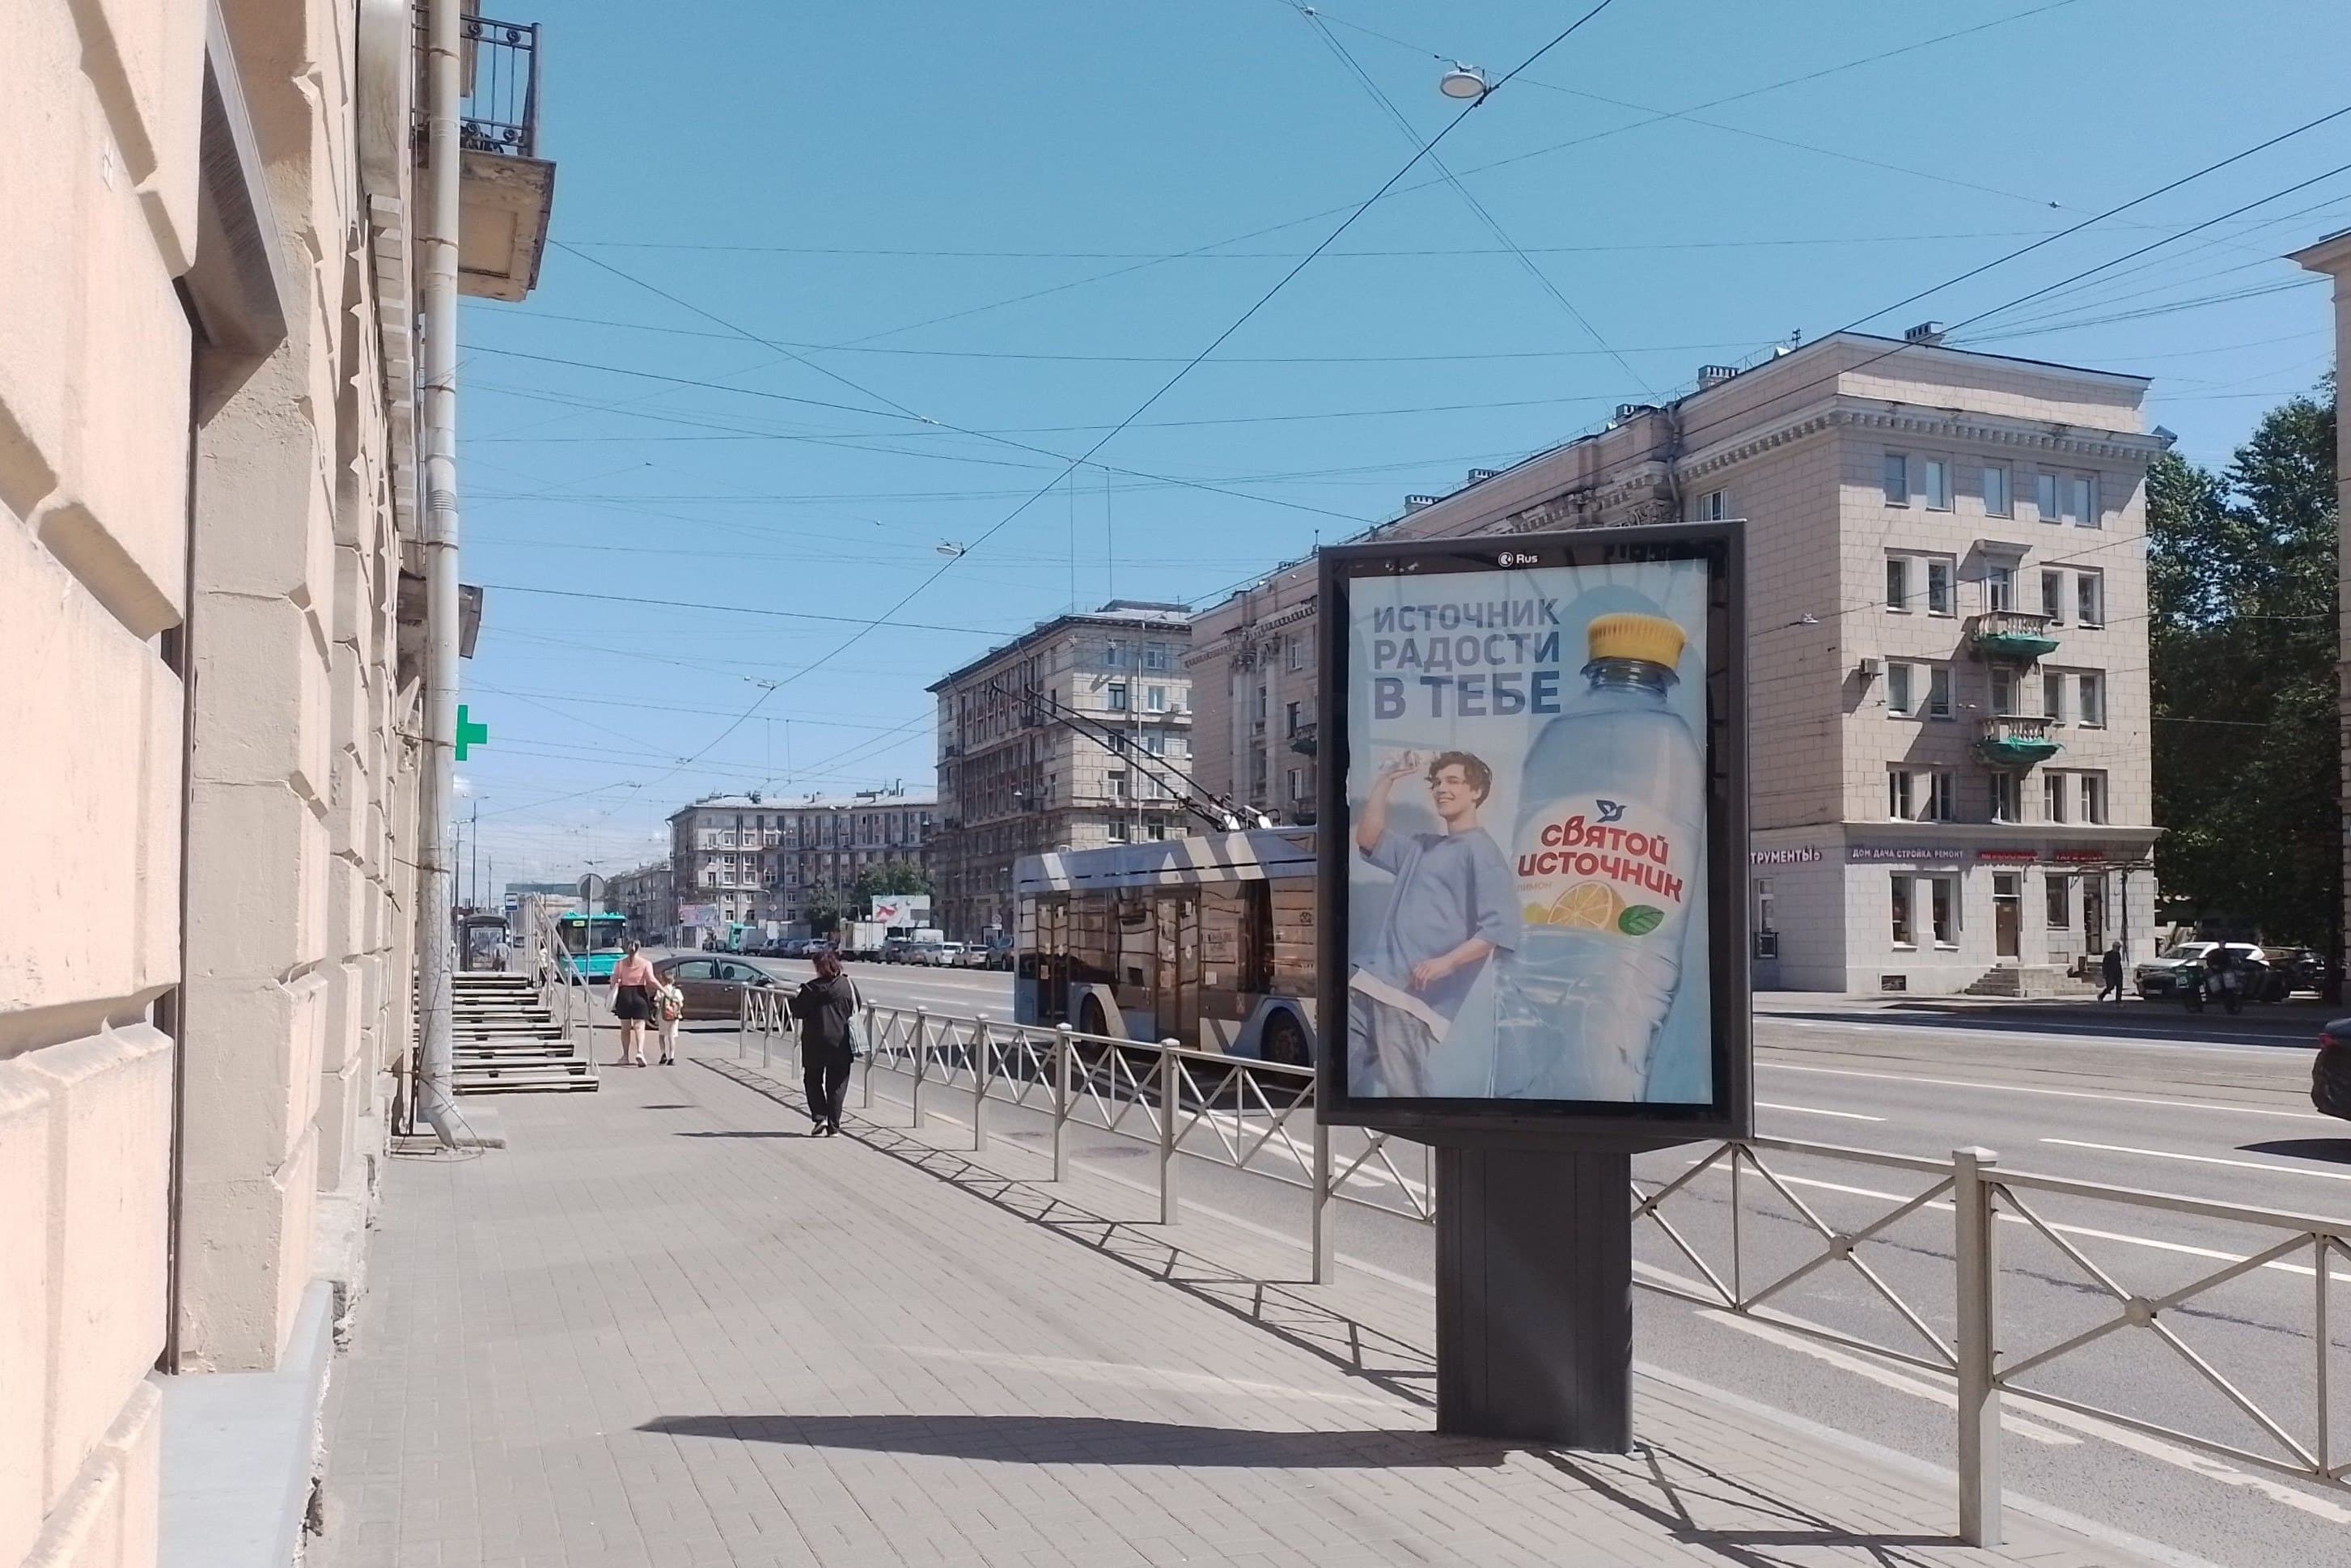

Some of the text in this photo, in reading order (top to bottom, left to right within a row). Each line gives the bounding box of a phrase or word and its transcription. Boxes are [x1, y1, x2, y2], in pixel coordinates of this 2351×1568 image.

[1516, 554, 1538, 564] Rus
[1374, 599, 1560, 634] ИСТОЧНИК
[1374, 632, 1560, 673] РАДОСТИ
[1375, 671, 1561, 719] В ТЕБЕ
[1541, 816, 1669, 865] СВЯТОЙ
[1852, 848, 1963, 858] ДОМ ДАЧА СТРОЙКА РЕМОНТ
[1518, 852, 1683, 903] ИСТОЧНИК
